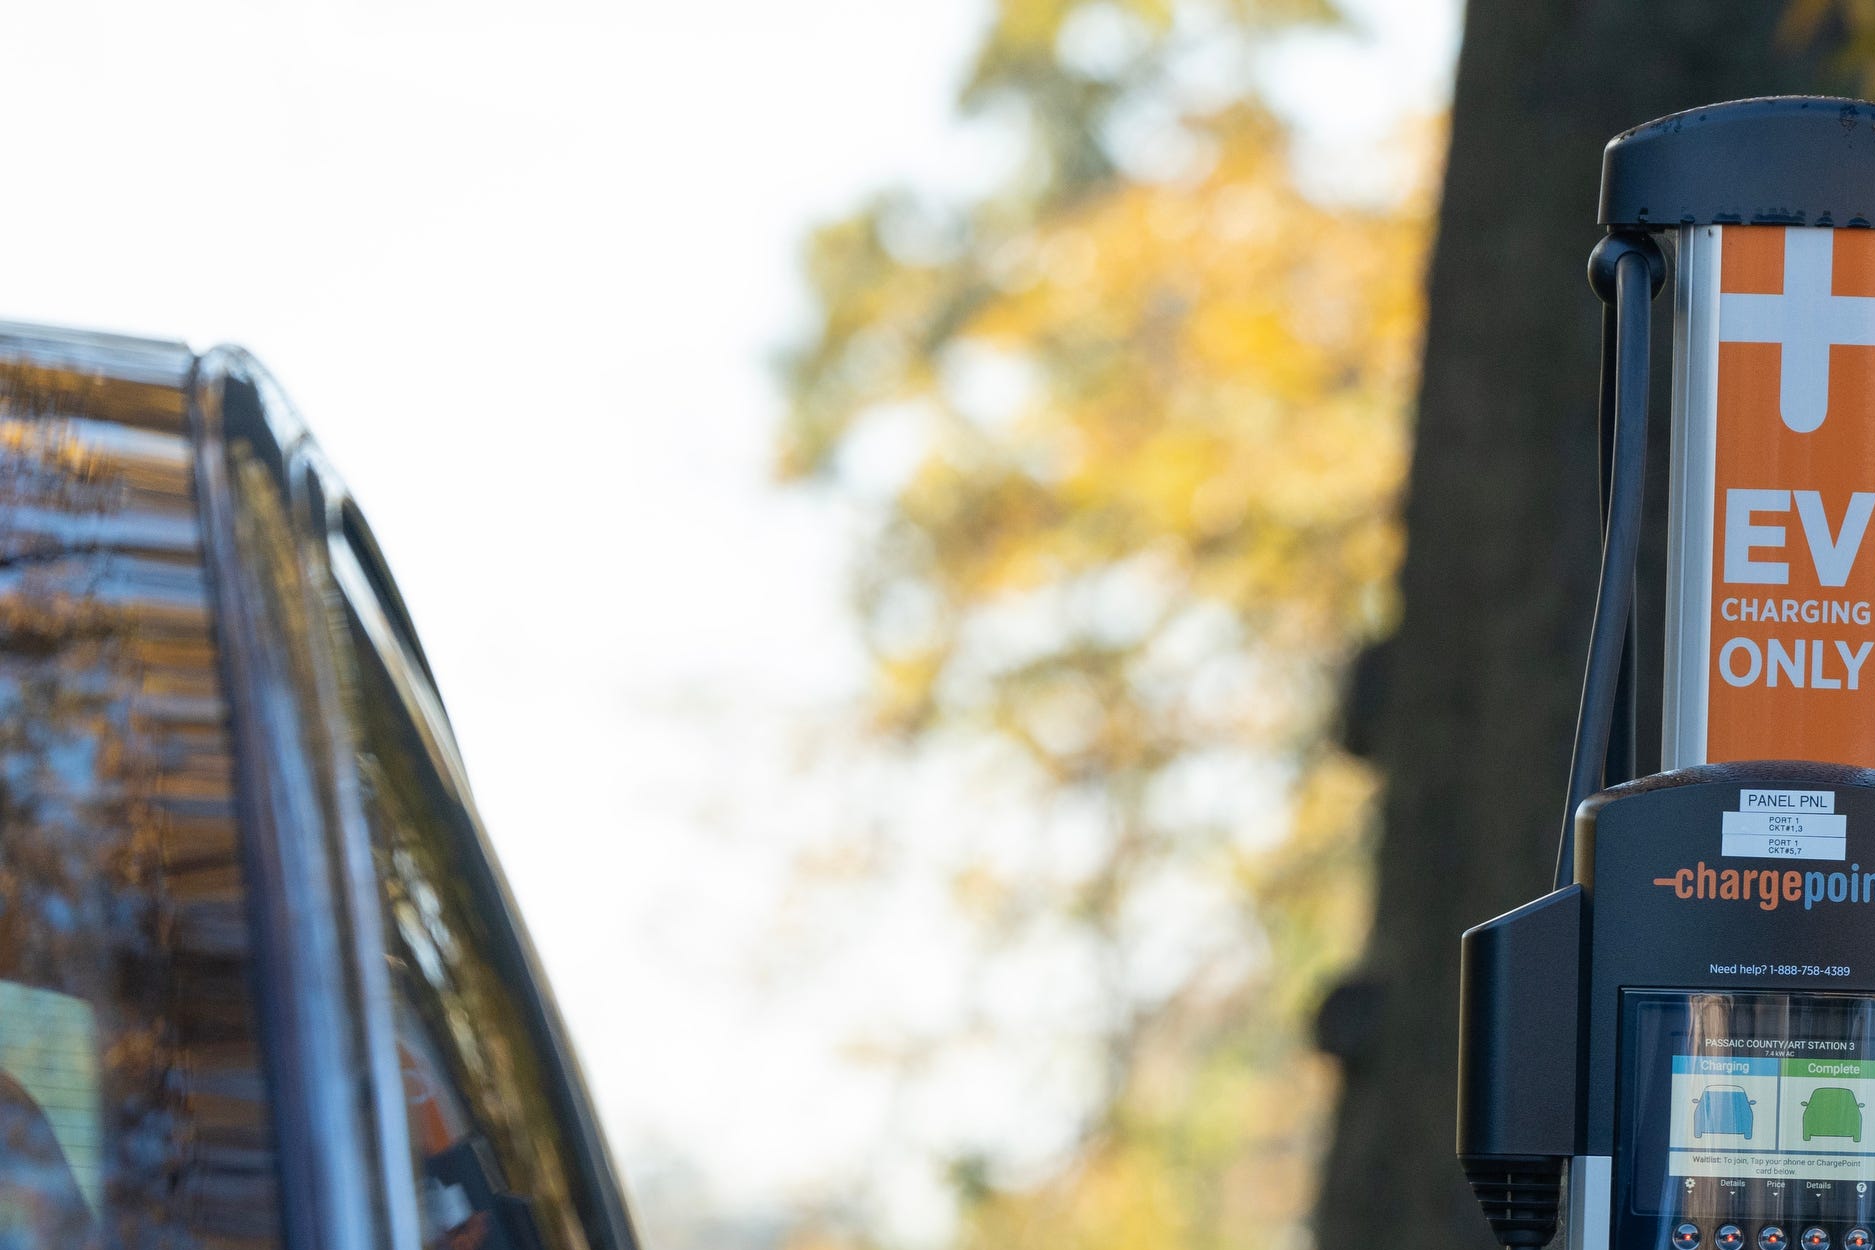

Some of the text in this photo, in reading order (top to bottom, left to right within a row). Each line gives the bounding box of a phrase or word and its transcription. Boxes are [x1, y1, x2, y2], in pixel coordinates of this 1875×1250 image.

[1721, 597, 1871, 625] CHARGING
[1718, 637, 1874, 690] ONLY
[1748, 794, 1828, 808] PANEL PNL
[1769, 816, 1793, 824] PORT
[1769, 824, 1803, 833] CKT#1,3
[1768, 839, 1792, 847] PORT
[1768, 847, 1802, 856] CKT#5,7
[1709, 964, 1851, 977] Need help? 1-888-758-4389
[1705, 1038, 1855, 1051] PASSAIC COUNTY/ART STATION 3
[1701, 1059, 1750, 1074] Charging
[1808, 1062, 1860, 1075] Complete
[1693, 1155, 1721, 1164] Waitlist:
[1724, 1156, 1732, 1164] To
[1734, 1157, 1749, 1165] join,
[1751, 1158, 1764, 1166] Tap
[1766, 1159, 1782, 1167] your
[1783, 1158, 1806, 1167] phone
[1816, 1159, 1861, 1168] ChargePoint
[1756, 1167, 1772, 1175] card
[1720, 1179, 1746, 1188] Details
[1766, 1180, 1785, 1188] Price
[1806, 1181, 1831, 1190] Details
